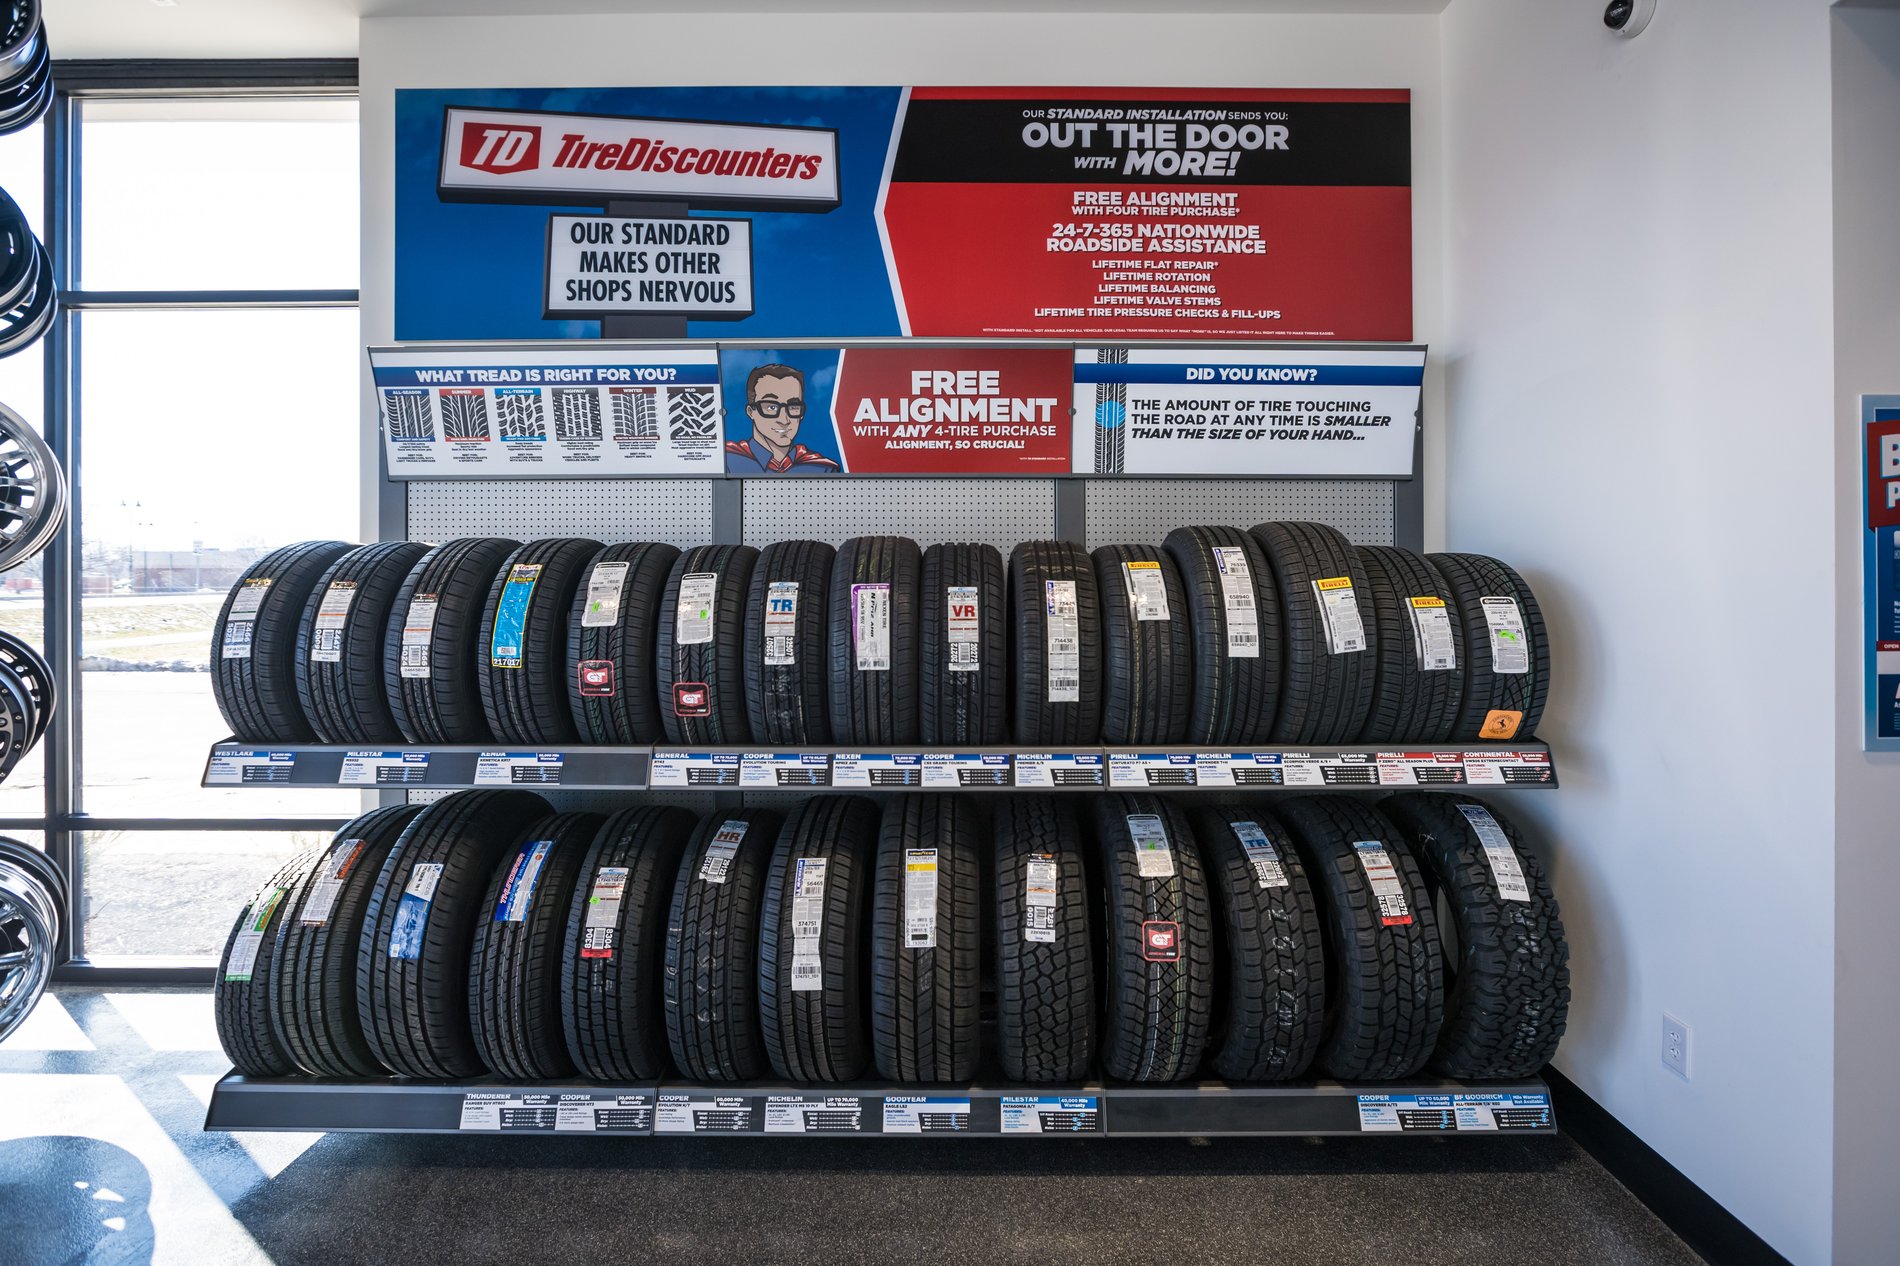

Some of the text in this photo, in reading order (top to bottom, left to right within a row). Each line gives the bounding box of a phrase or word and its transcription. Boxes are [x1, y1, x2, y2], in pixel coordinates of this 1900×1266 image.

[1023, 108, 1288, 120] OUR STANDARD INSTALLATION SENDS YOU:
[1022, 122, 1289, 150] OUT THE DOOR
[472, 129, 533, 166] TD
[552, 134, 823, 180] TireDiscounters
[1074, 151, 1240, 176] WITH MORE!
[1074, 192, 1238, 207] FREE ALIGNMENT
[1072, 206, 1105, 215] WITH
[1106, 206, 1138, 215] FOUR
[1141, 207, 1166, 216] TIRE
[570, 222, 731, 246] OUR STANDARD
[1052, 224, 1260, 239] 24-7-365 NATIONWIDE
[1047, 239, 1266, 254] ROADSIDE ASSISTANCE
[579, 250, 721, 275] MAKES OTHER
[1092, 260, 1142, 269] LIFETIME
[1145, 260, 1171, 269] FLAT
[1103, 272, 1211, 281] LIFETIME ROTATION
[566, 279, 736, 304] SHOPS NERVOUS
[1098, 284, 1216, 294] LIFETIME BALANCING
[1094, 296, 1221, 306] LIFETIME VALVE STEMS
[1035, 307, 1280, 319] LIFETIME TIRE PRESSURE CHECKS & FILL-UPS
[415, 368, 677, 383] WHAT TREAD IS RIGHT FOR YOU?
[1186, 368, 1317, 381] DID YOU KNOW?
[911, 371, 1000, 395] FREE
[853, 398, 1057, 422] ALIGNMENT
[1131, 400, 1371, 412] THE AMOUNT OF TIRE TOUCHING
[1131, 414, 1391, 427] THE ROAD AT ANY TIME IS SMALLER
[853, 425, 1057, 437] WITH ANY 4-TIRE PURCHASE
[1131, 428, 1172, 439] THAN
[1176, 429, 1204, 439] THE
[1207, 429, 1242, 439] SIZE
[1244, 429, 1265, 439] OF
[1268, 429, 1308, 440] YOUR
[885, 440, 1024, 450] ALIGNMENT, SO CRUCIAL!
[771, 599, 793, 612] TR
[952, 605, 976, 618] VR
[718, 832, 740, 841] HR
[1246, 839, 1268, 847] TR
[584, 928, 594, 949] 8304
[604, 928, 614, 949] 8304
